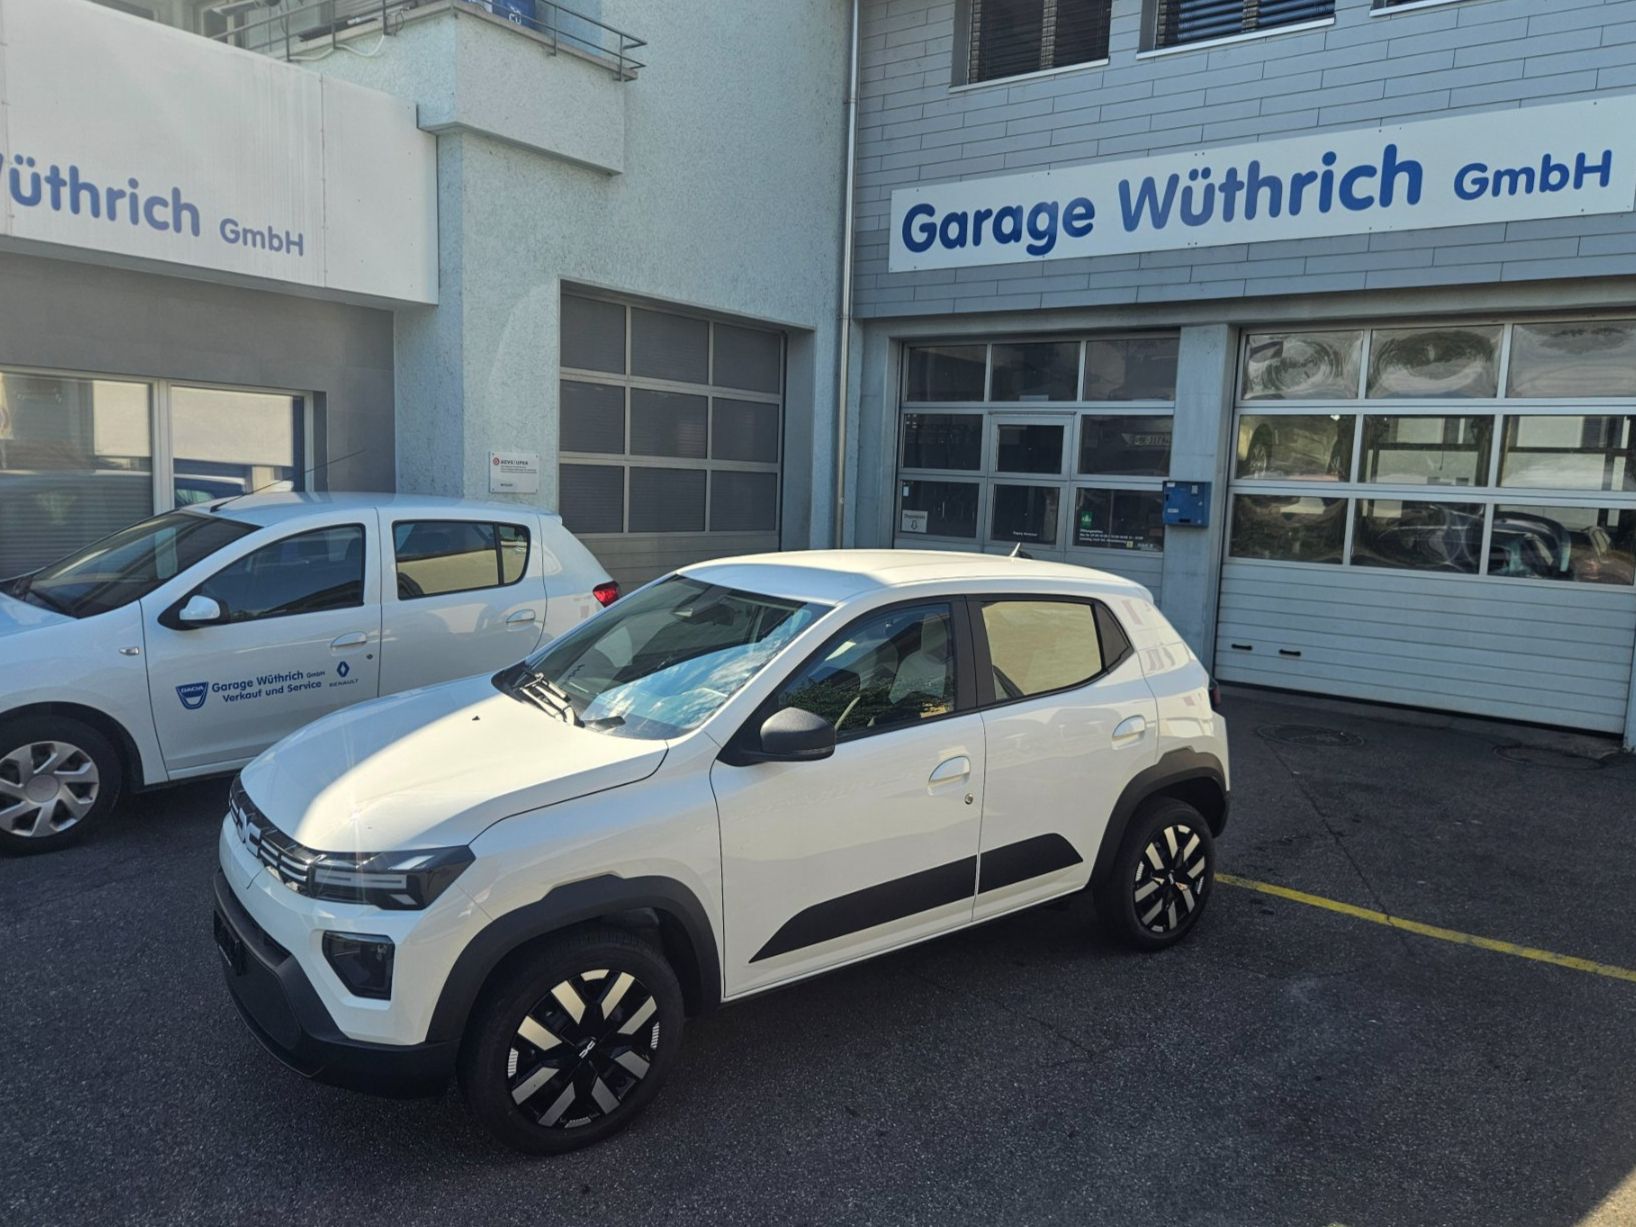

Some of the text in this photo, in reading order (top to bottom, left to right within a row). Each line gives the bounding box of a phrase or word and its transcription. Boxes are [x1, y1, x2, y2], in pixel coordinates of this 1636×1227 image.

[0, 153, 304, 257] üthrich GmbH
[901, 143, 1613, 256] Garage Wüthrich GmbH
[212, 680, 254, 693] Garage
[256, 670, 304, 686] Wüthrich
[222, 680, 322, 703] Verkauf und Service
